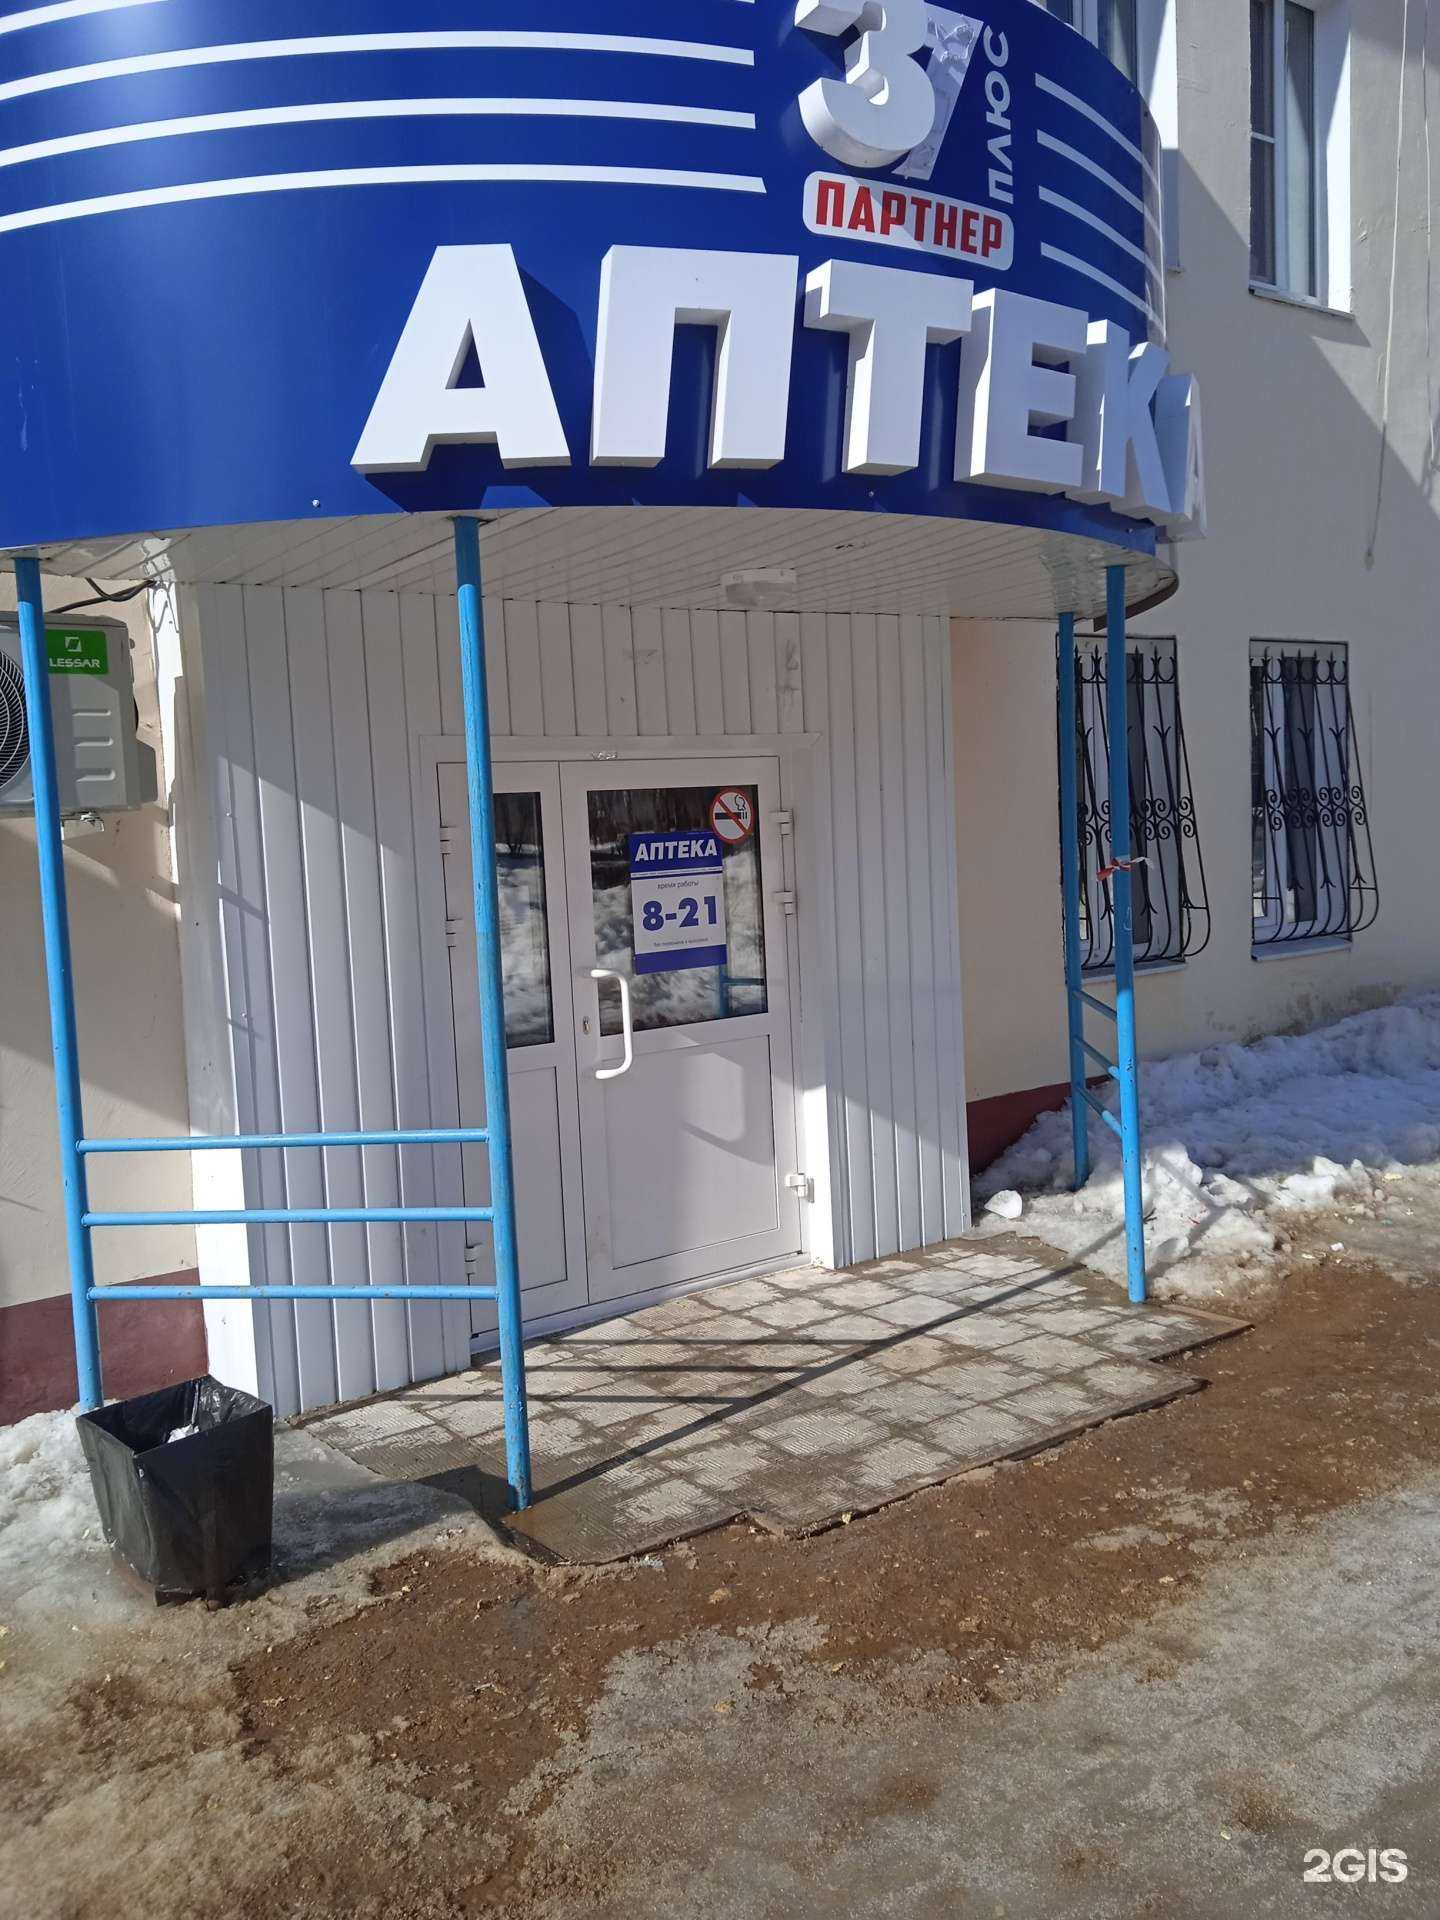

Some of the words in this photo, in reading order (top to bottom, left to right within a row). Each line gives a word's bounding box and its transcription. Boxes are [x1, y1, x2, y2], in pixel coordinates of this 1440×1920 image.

[983, 25, 1013, 204] ПЛЮС
[816, 179, 1003, 258] ПАРТНЕР
[49, 657, 100, 668] LESSAR
[635, 838, 718, 861] АПТЕКА
[642, 895, 717, 931] 8-21
